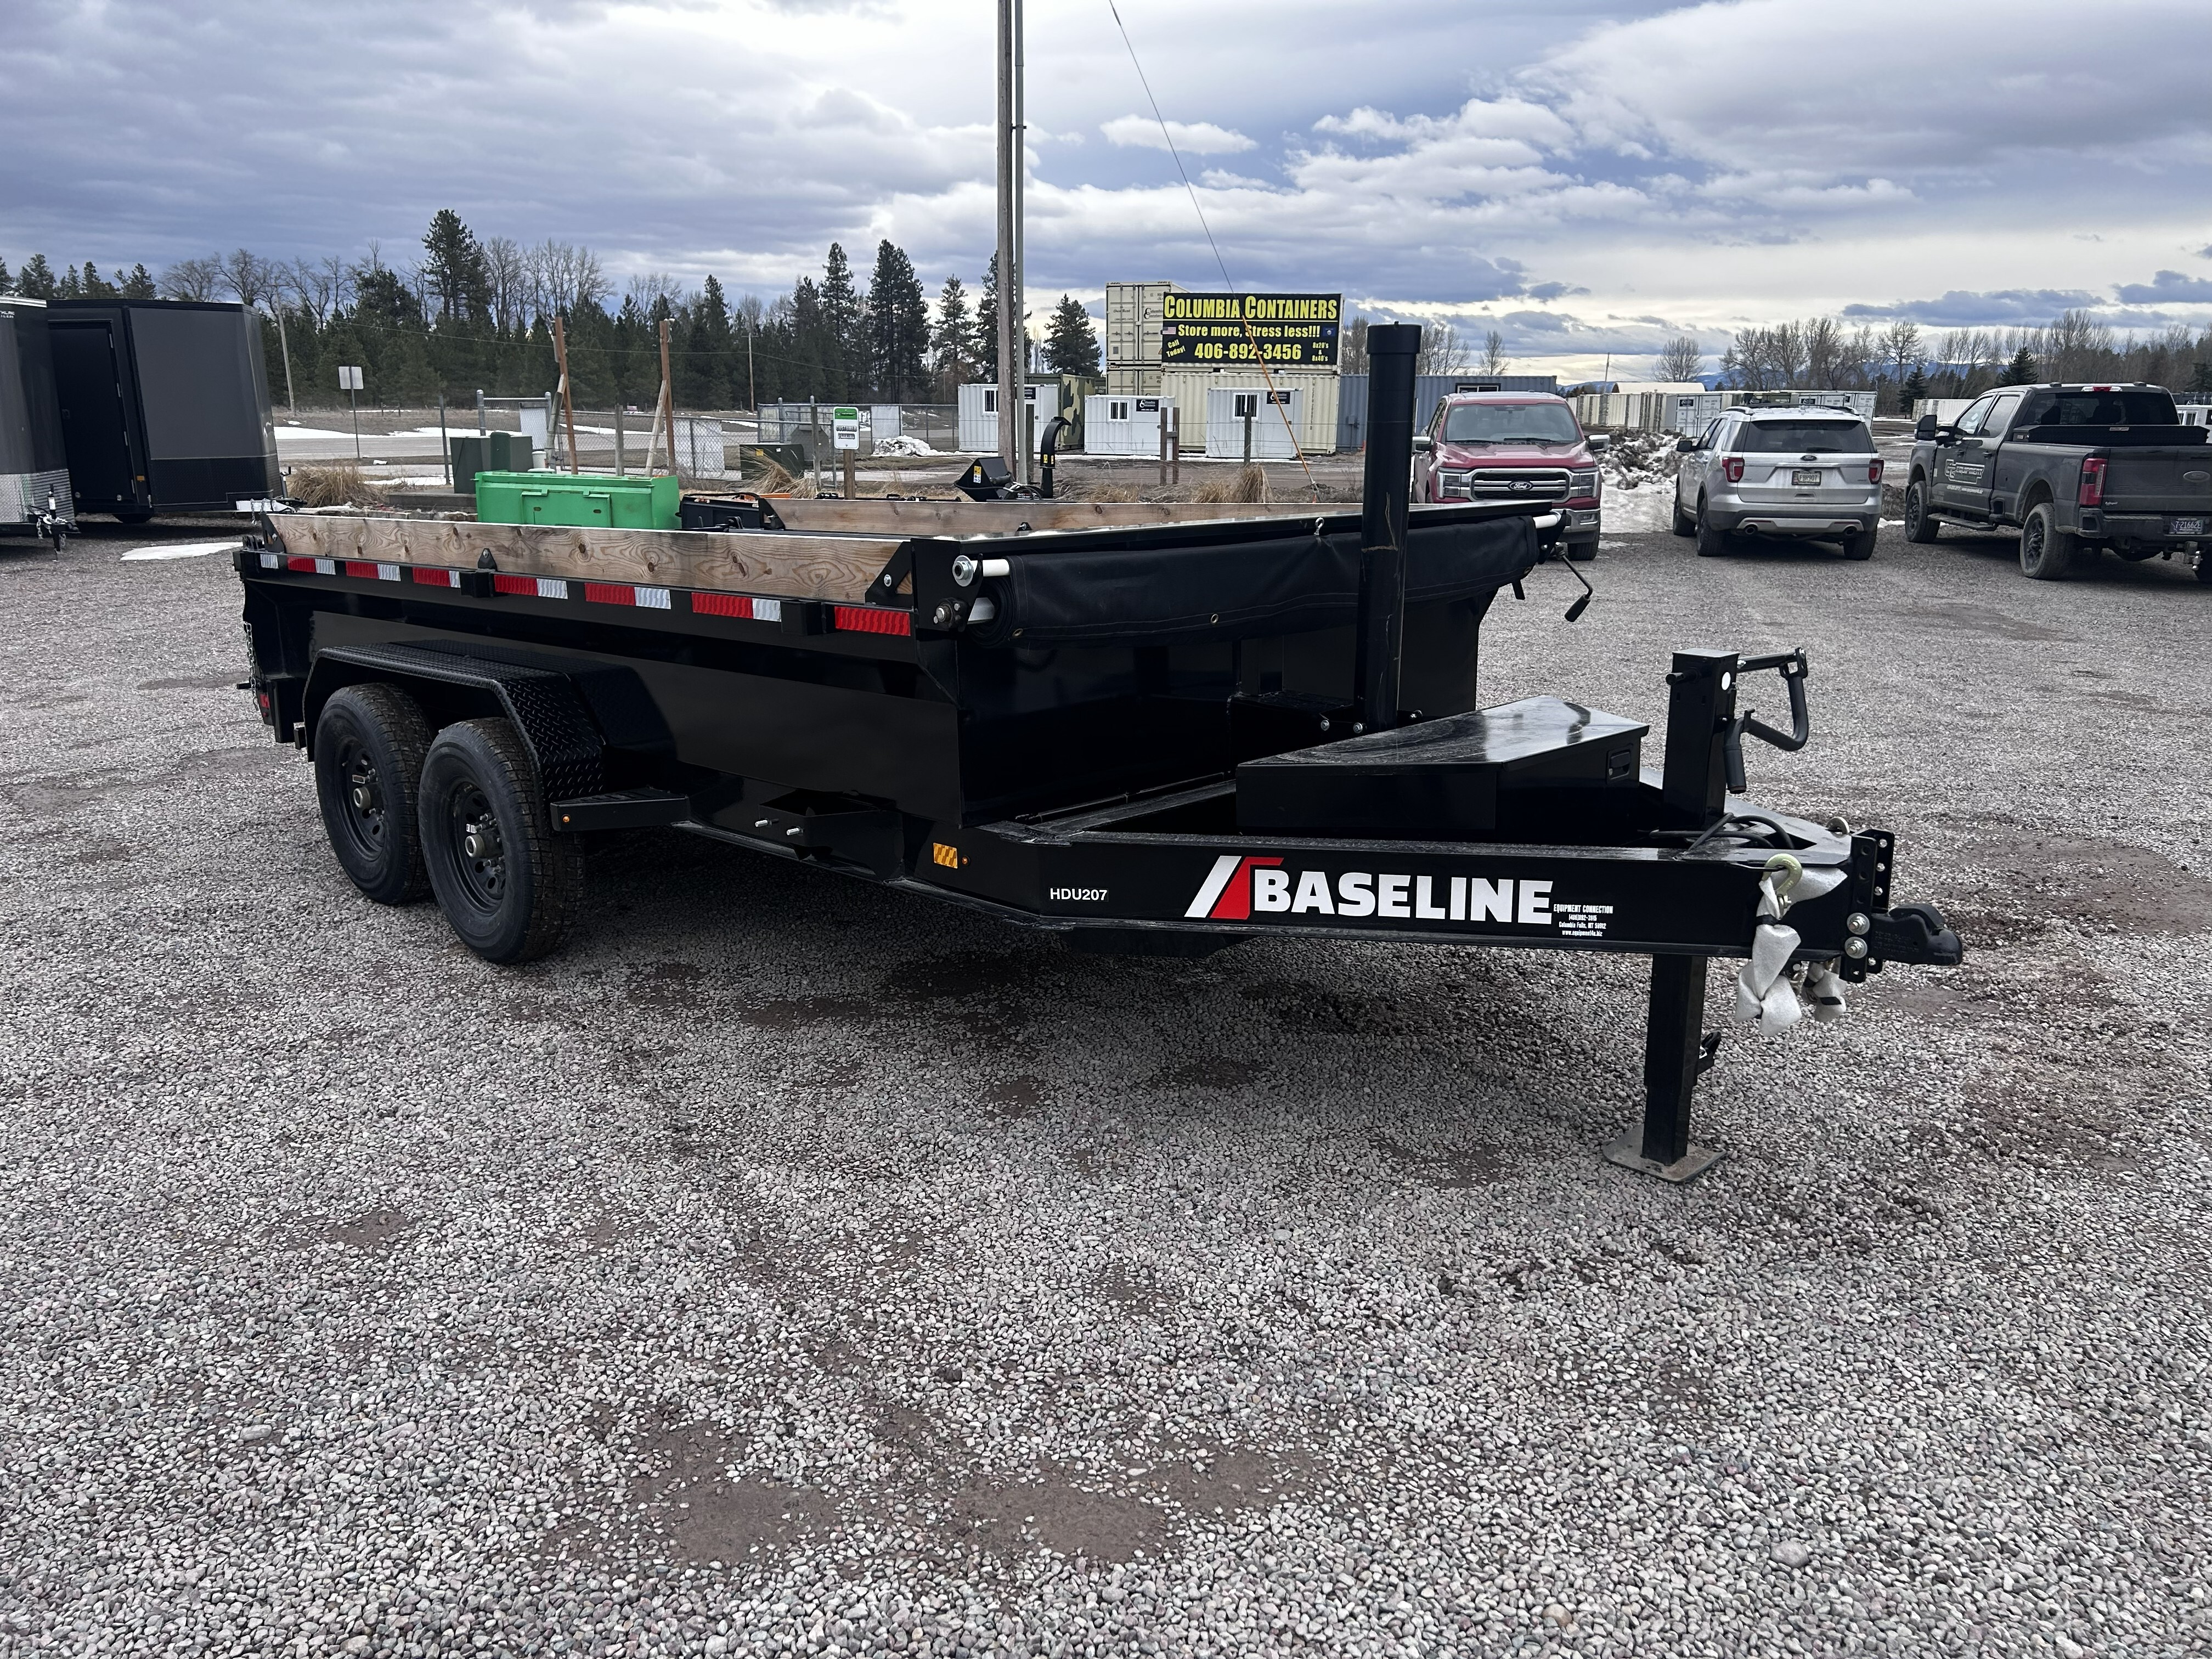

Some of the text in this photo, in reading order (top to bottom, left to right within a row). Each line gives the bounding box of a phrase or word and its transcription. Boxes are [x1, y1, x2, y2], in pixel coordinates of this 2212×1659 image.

[1178, 324, 1321, 338] Store more, Stress less!!!
[1167, 339, 1180, 348] Call
[1166, 345, 1186, 357] Today!
[1194, 343, 1302, 360] 406-892-3456
[1050, 888, 1108, 901] HDU207
[1254, 869, 1553, 924] BASELINE
[1553, 904, 1613, 914] EQUIPMENT CONNECTION
